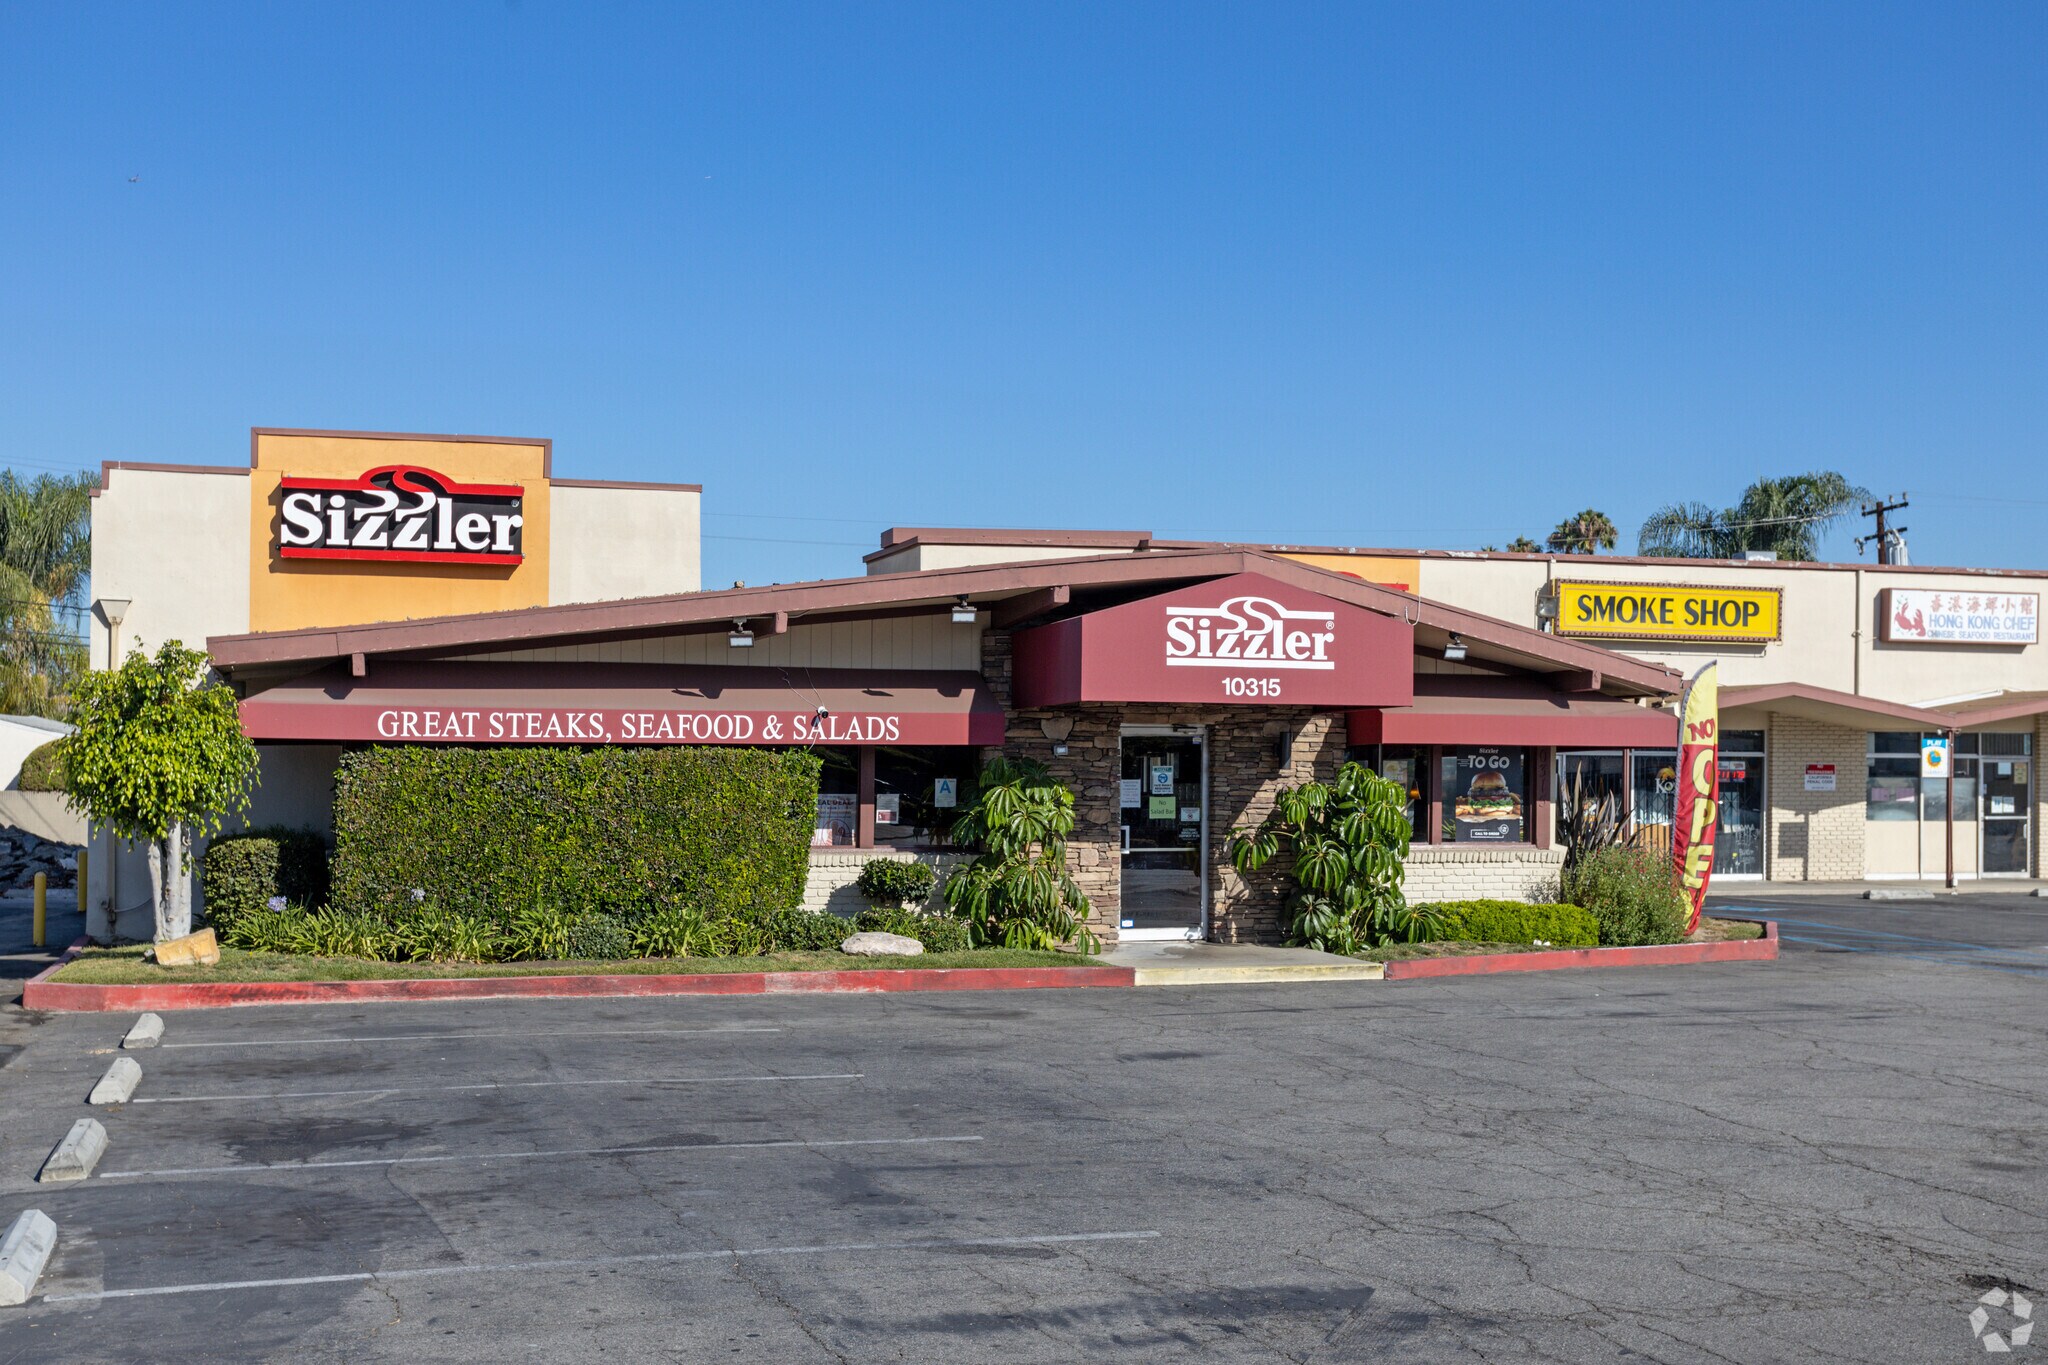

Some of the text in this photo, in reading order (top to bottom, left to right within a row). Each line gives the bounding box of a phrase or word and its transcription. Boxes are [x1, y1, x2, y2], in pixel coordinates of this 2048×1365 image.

[281, 486, 524, 552] Sizzler
[1577, 594, 1760, 627] SMOKE SHOP
[1929, 614, 2036, 631] HONG KONG CHEF
[1166, 609, 1335, 661] Sizzler
[1927, 629, 2035, 641] CHINESE SEAFOOD RESTAURANT
[1221, 677, 1282, 697] 10315
[377, 710, 900, 743] GREAT STEAKS, SEAFOOD & SALADS
[1687, 717, 1716, 742] NO
[1468, 755, 1510, 769] TO GO
[939, 780, 952, 794] A
[1654, 777, 1675, 793] Ko
